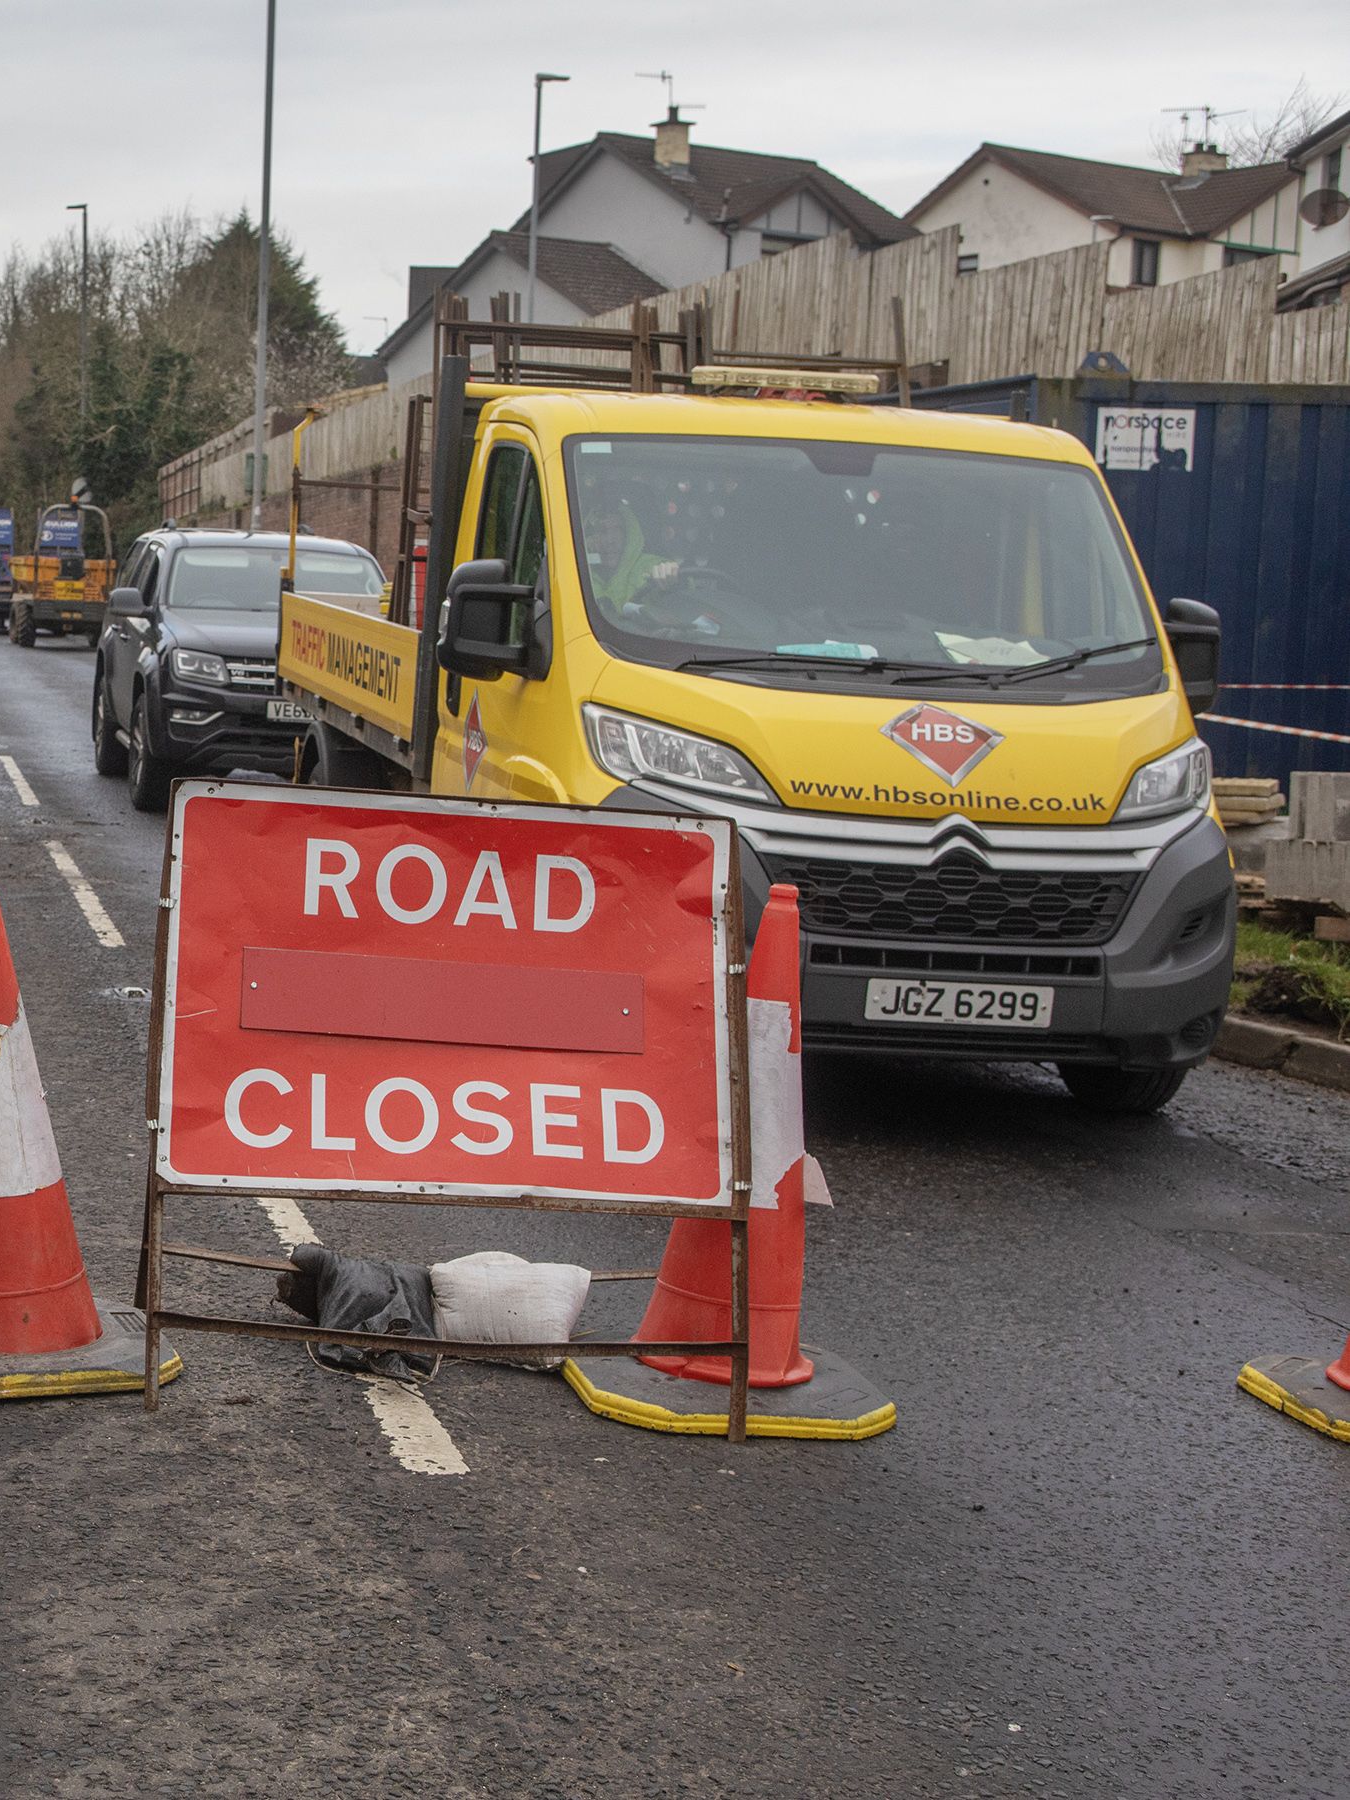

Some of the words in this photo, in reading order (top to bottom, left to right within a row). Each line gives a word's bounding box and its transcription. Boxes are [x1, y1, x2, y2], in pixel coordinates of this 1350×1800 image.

[231, 669, 245, 677] V6
[291, 620, 326, 671] TRAFFIC
[326, 632, 401, 703] MANAGEMENT
[911, 723, 975, 744] HBS
[790, 779, 1107, 811] www.hbsonline.co.uk
[304, 838, 596, 933] ROAD
[881, 985, 945, 1018] JGZ
[954, 989, 1039, 1021] 6299
[224, 1068, 665, 1164] CLOSED
